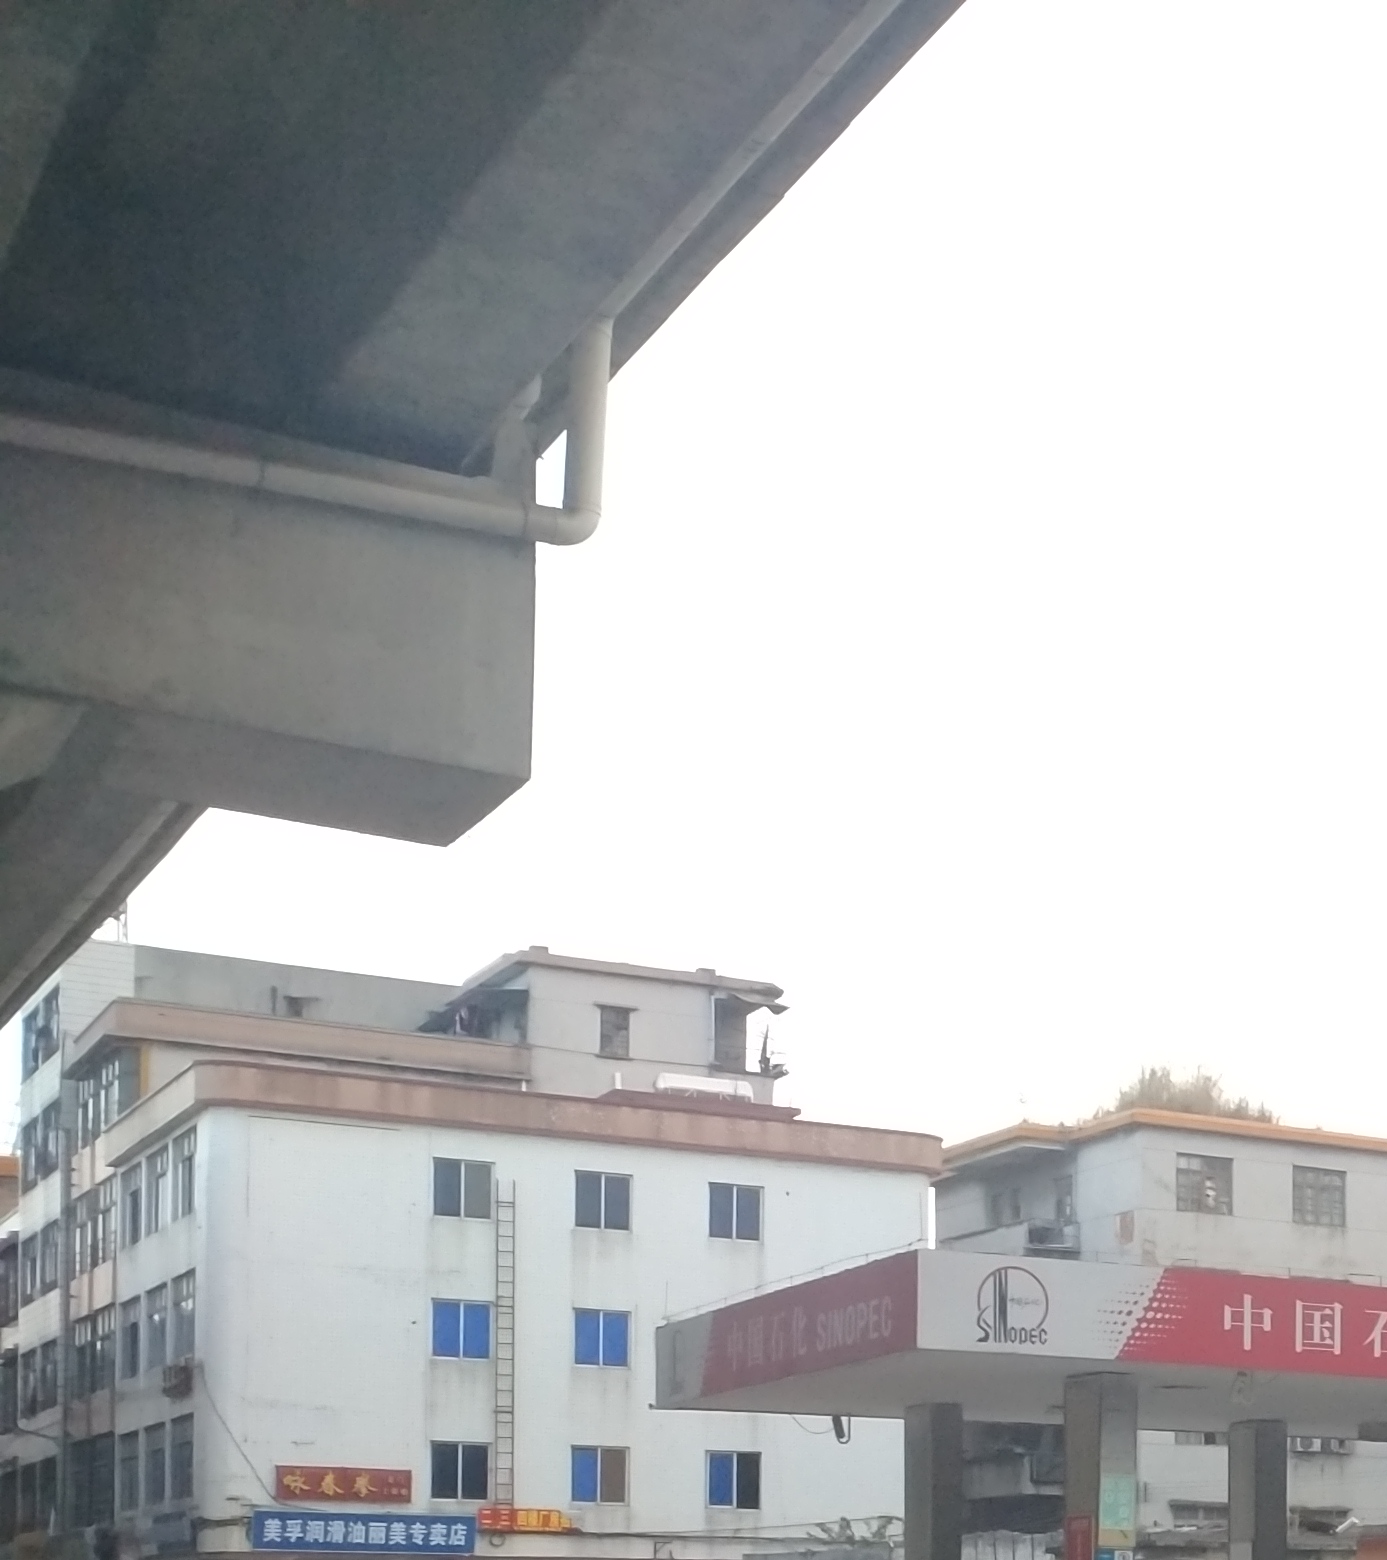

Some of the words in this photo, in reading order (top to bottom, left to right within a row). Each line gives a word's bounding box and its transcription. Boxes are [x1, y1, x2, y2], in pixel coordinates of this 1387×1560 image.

[727, 1306, 807, 1371] 中国石化
[817, 1295, 893, 1352] SINOPEC
[262, 1518, 468, 1547] 美孚润滑油丽美专卖店
